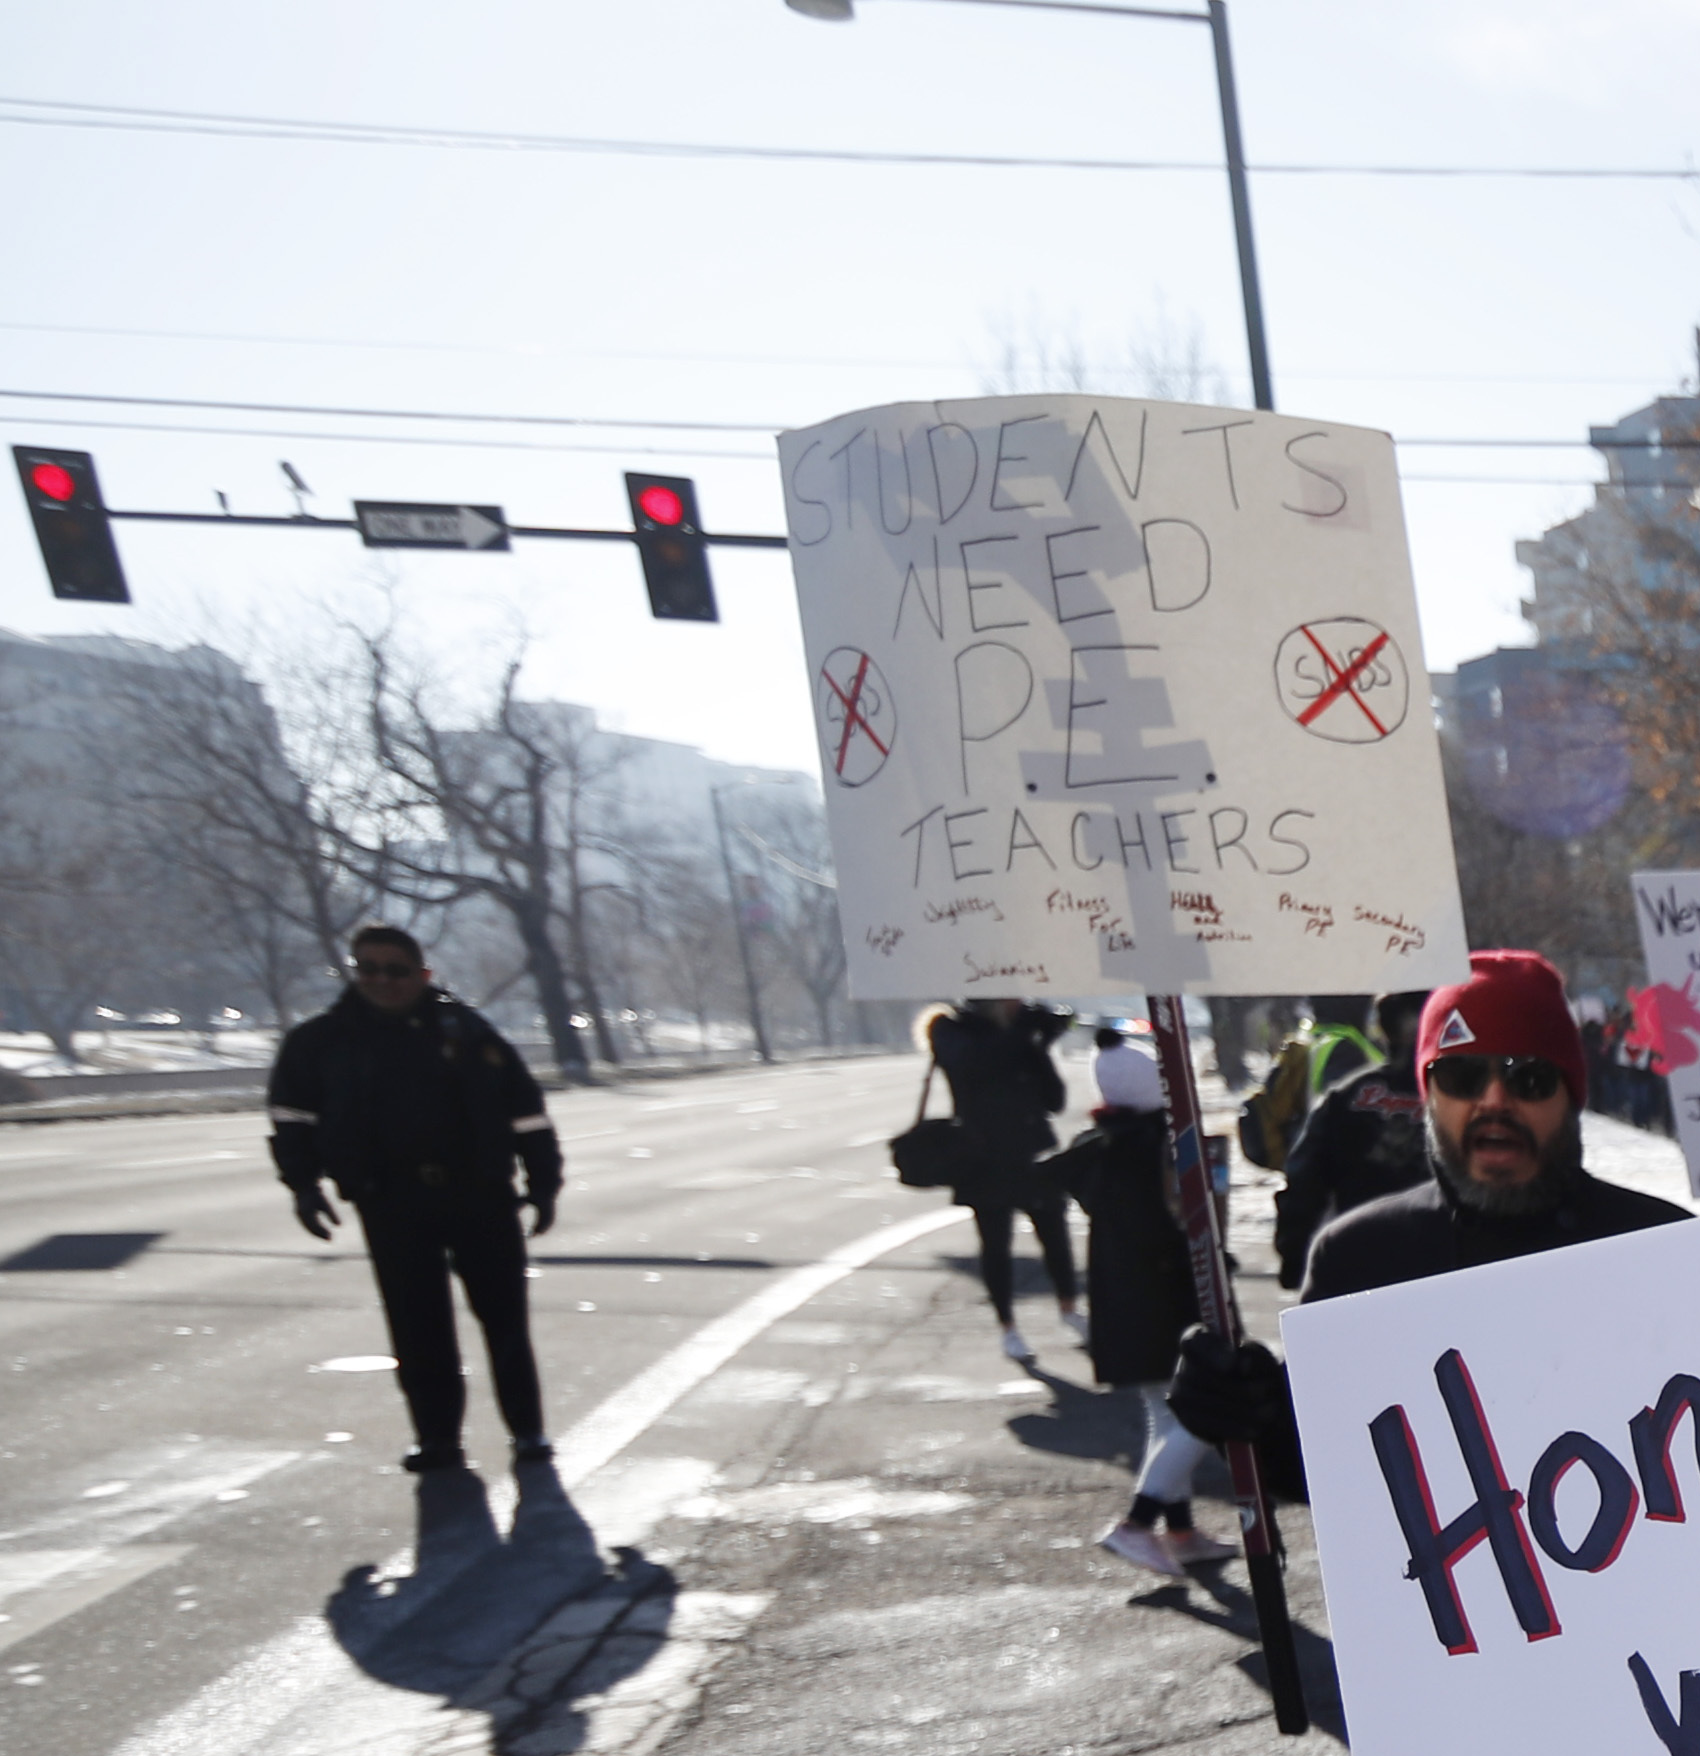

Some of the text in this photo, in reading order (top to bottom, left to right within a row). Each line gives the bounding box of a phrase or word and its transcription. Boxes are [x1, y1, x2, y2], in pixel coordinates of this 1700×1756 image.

[791, 409, 1347, 546] STUDENTS
[893, 518, 1212, 641] NEED
[899, 806, 1316, 889] TEACHERS
[1353, 904, 1426, 950] Secondary
